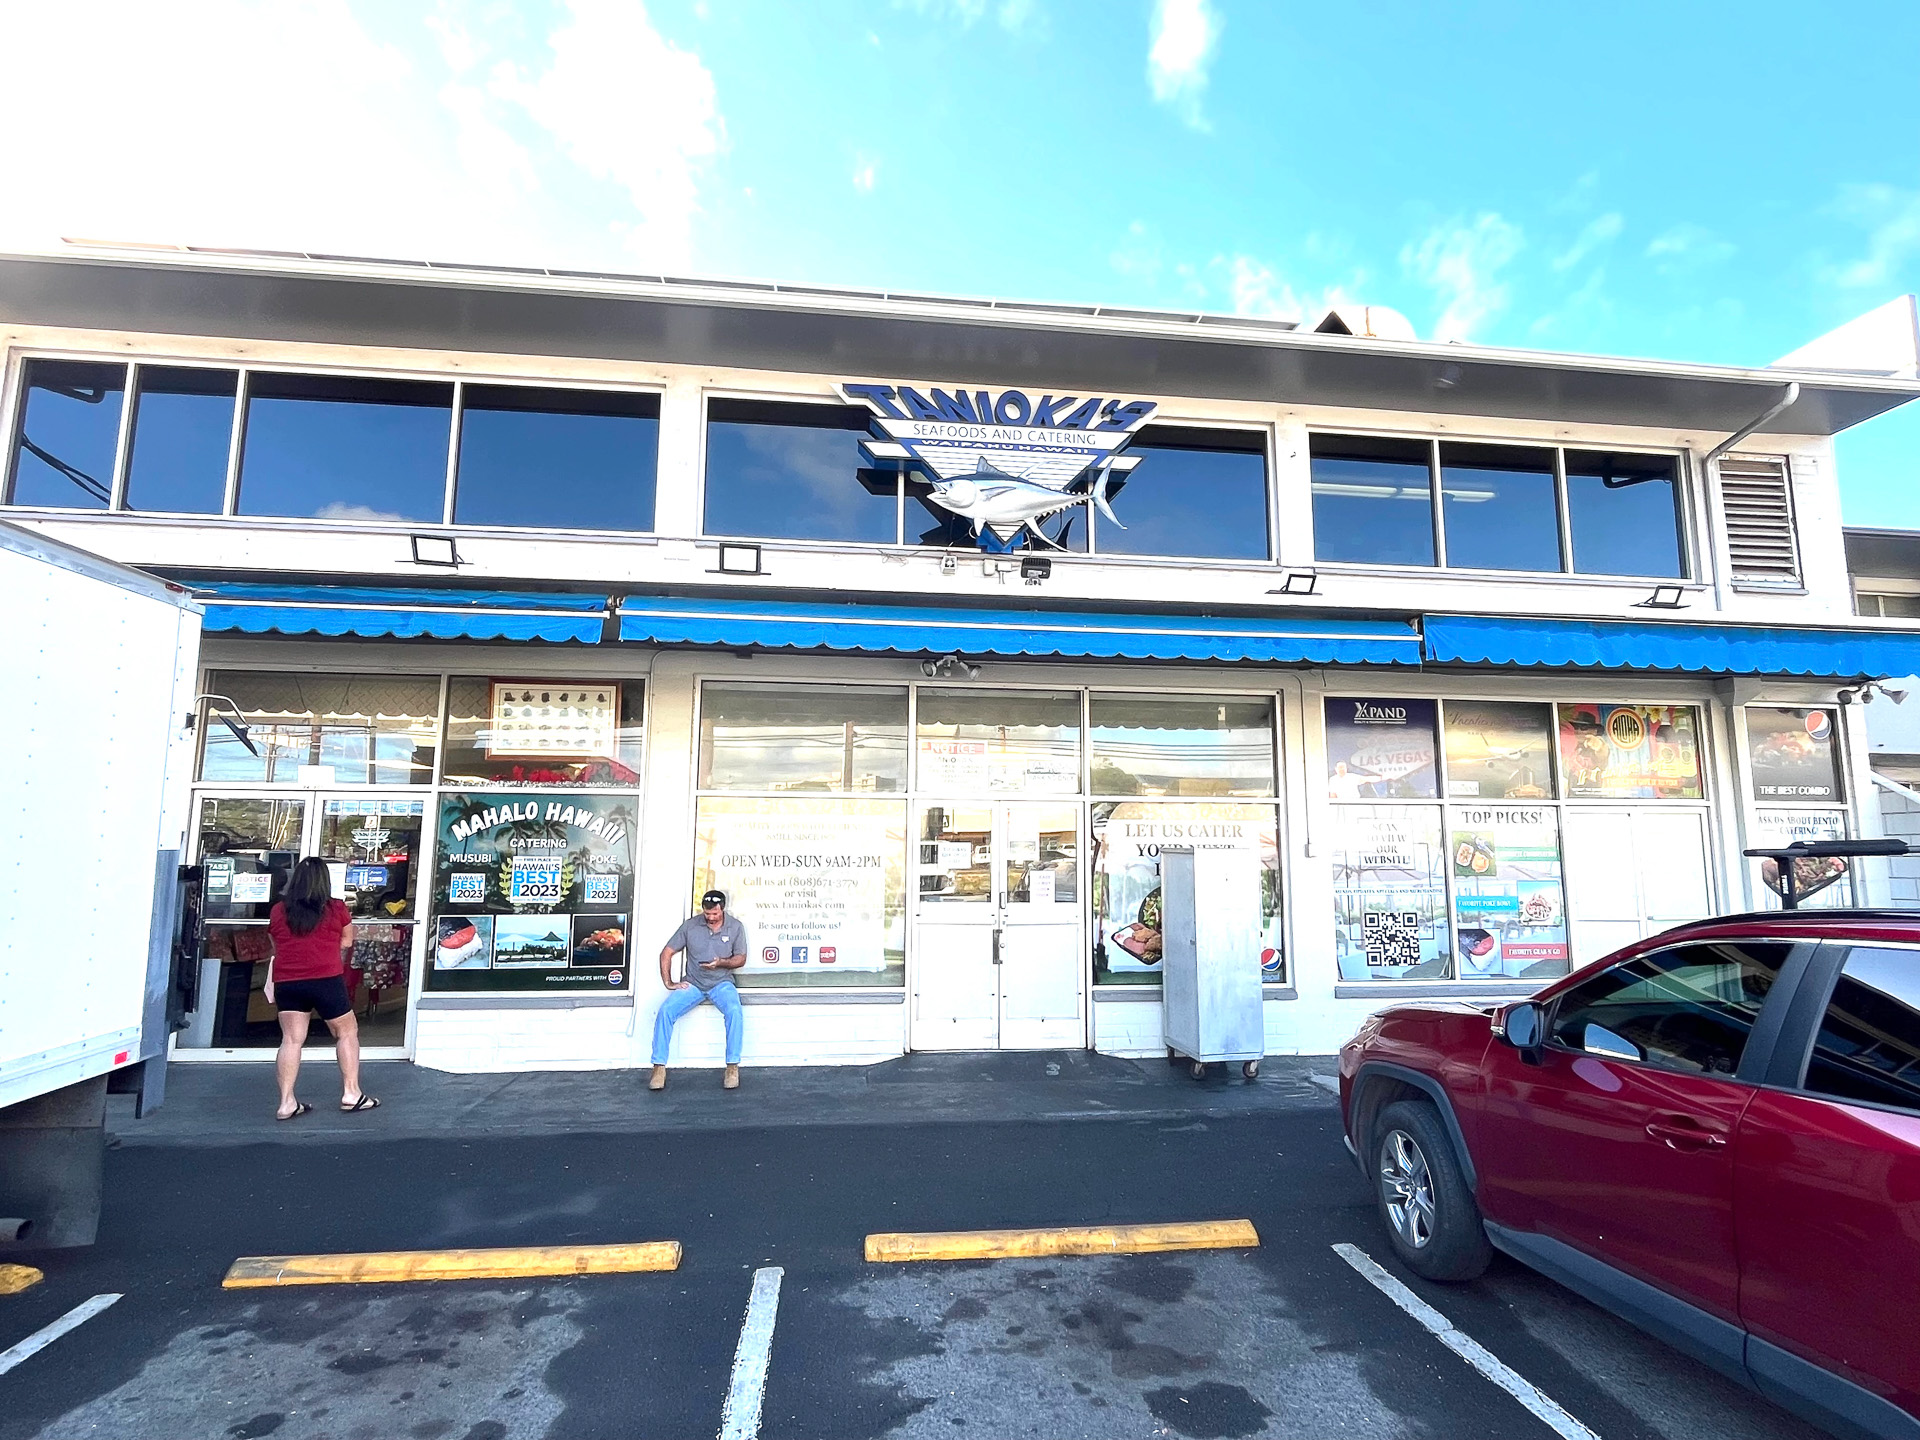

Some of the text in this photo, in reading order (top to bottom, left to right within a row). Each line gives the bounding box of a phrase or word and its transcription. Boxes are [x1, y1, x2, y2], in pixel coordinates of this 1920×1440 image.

[842, 383, 1158, 431] TANIOKA'S
[913, 423, 1096, 446] SEAFOODS AND CATERING
[921, 439, 1090, 455] WAIPAHU HAWAII
[1354, 702, 1406, 718] XPAND
[1612, 714, 1640, 743] ALOHA
[931, 743, 975, 754] NOTICE
[1359, 756, 1381, 767] LAS
[1385, 750, 1431, 764] VEGAS
[1759, 786, 1831, 796] THE BEST COMBO
[451, 801, 539, 841] MAHALO
[1462, 811, 1543, 824] TOP PICKS!
[1787, 816, 1811, 824] ABOUT
[1813, 816, 1838, 825] BENTO
[1125, 823, 1243, 838] LET US CATER
[1373, 823, 1398, 831] SCAN
[510, 838, 567, 848] CATERING
[1376, 845, 1398, 853] OUR
[450, 853, 492, 863] MUSUBI
[589, 855, 617, 864] POKE
[721, 855, 881, 868] OPEN WED-SUN 9AM-2PM
[1364, 855, 1410, 864] WEBSITE!
[514, 863, 560, 871] HAWAII'S
[513, 870, 560, 884] BEST
[452, 880, 484, 890] BEST
[586, 881, 617, 890] BEST
[743, 877, 761, 886] Call
[777, 878, 786, 886] at
[789, 877, 858, 888] (808)671-3779
[457, 890, 483, 898] 2023
[520, 884, 559, 897] 2023
[591, 890, 617, 899] 2023
[797, 889, 817, 898] visit
[755, 901, 845, 909] www.taniokas.com
[758, 921, 769, 930] Be
[791, 922, 800, 930] to
[801, 921, 827, 930] follow
[829, 921, 841, 930] us!
[777, 933, 822, 942] @taniokas
